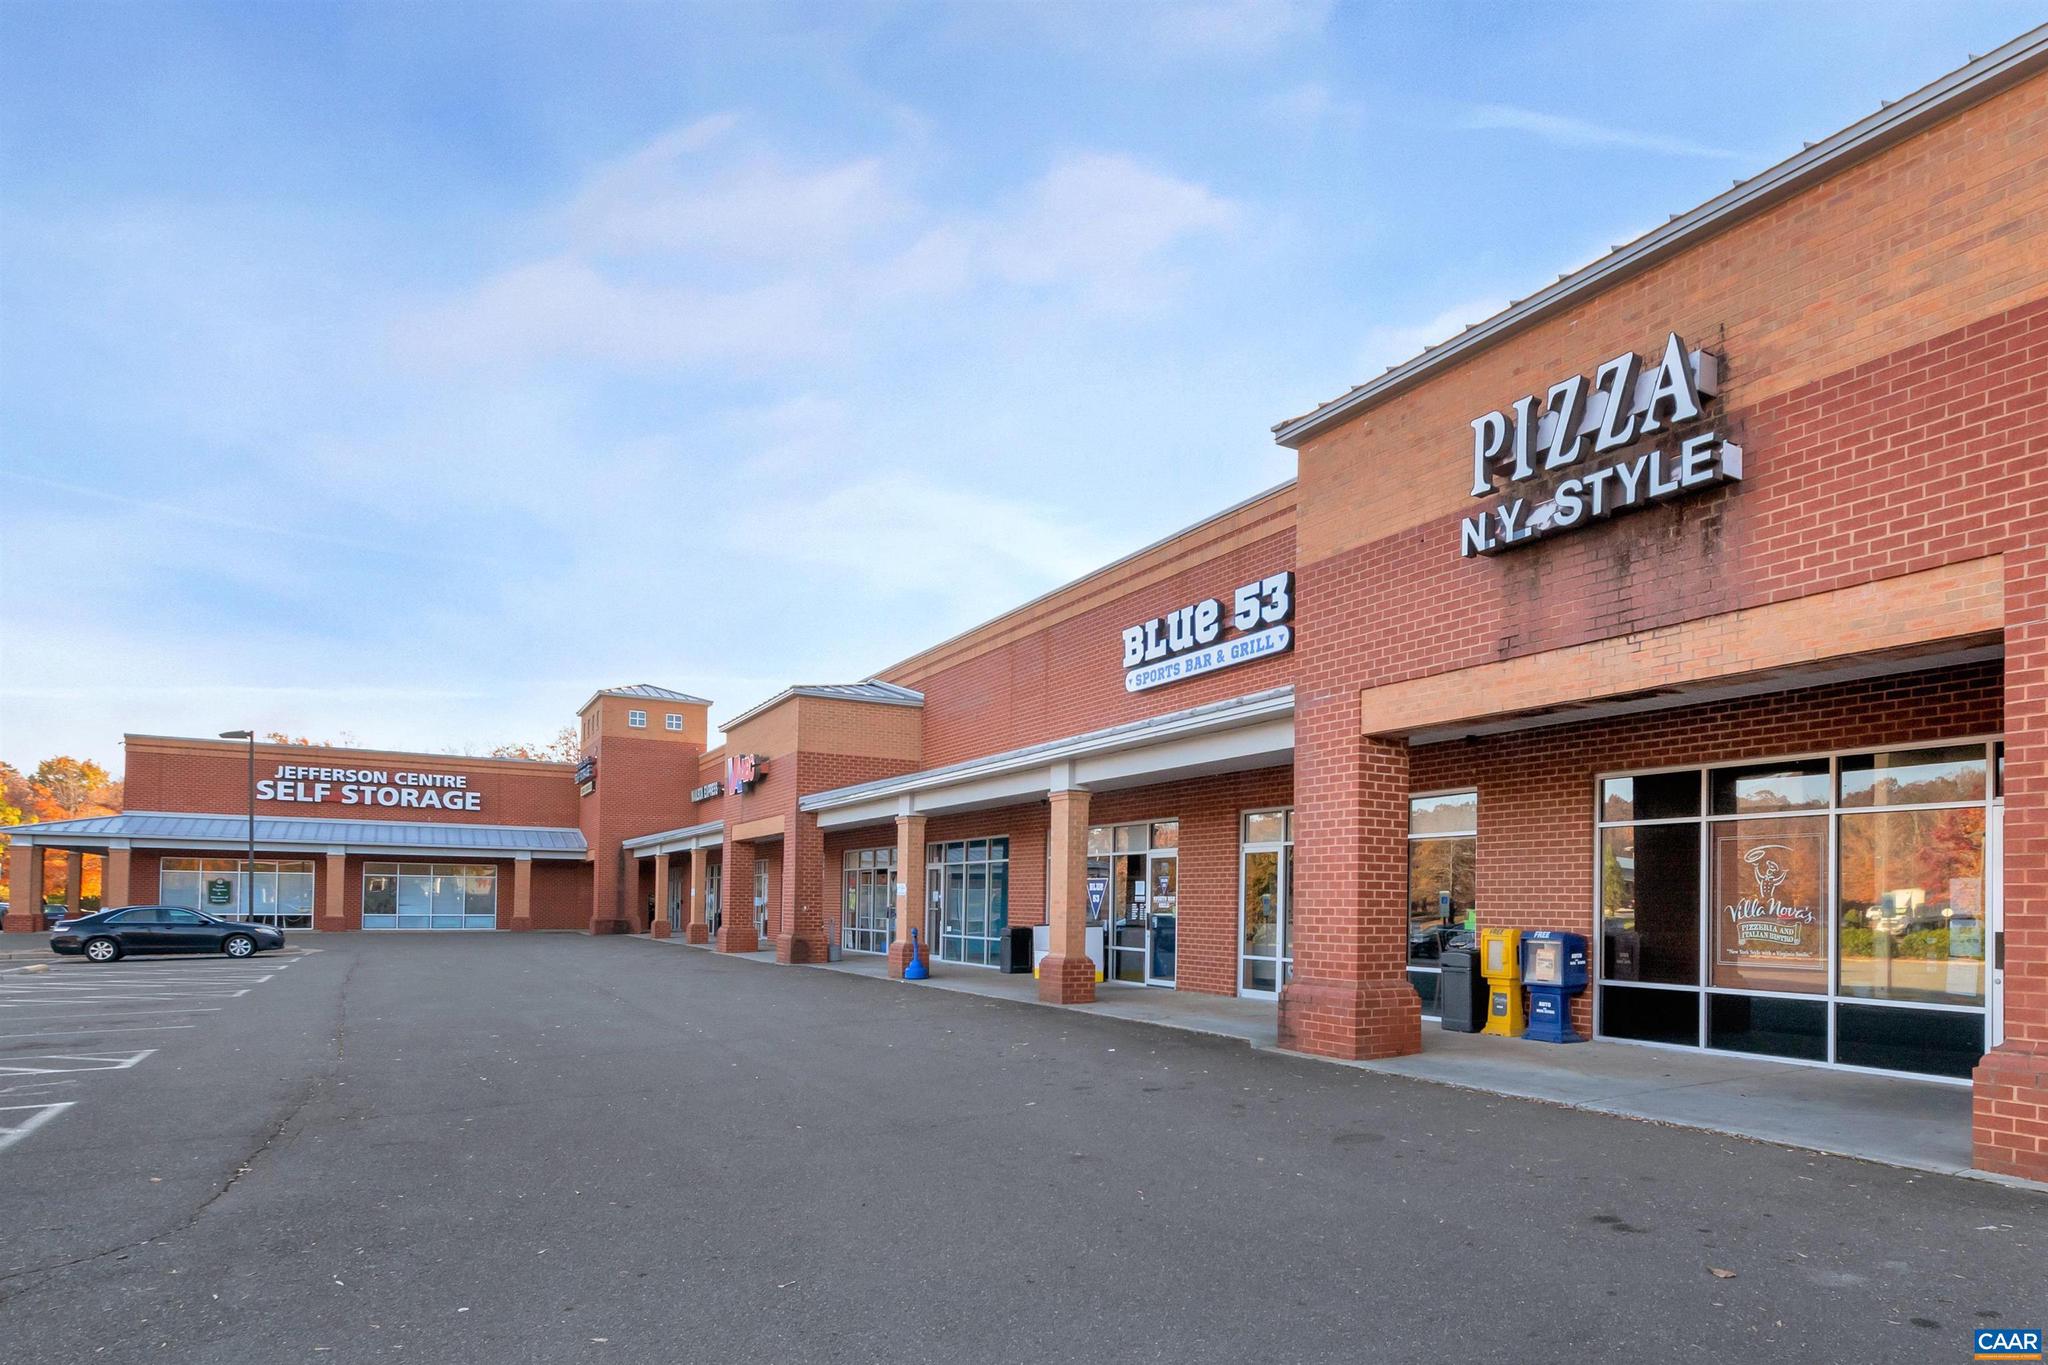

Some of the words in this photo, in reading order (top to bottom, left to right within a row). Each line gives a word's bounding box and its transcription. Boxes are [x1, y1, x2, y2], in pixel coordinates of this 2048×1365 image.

[1470, 331, 1699, 497] PIZZA
[1461, 498, 1532, 557] N.Y.
[1553, 432, 1716, 526] STYLE
[1234, 571, 1290, 631] 53
[1135, 662, 1181, 687] SPORTS
[1185, 652, 1212, 673] BAR
[1216, 649, 1225, 663] &
[1230, 634, 1275, 660] GRILL
[274, 765, 388, 784] JEFFERSON
[394, 772, 467, 788] CENTRE
[256, 780, 331, 803] SELF
[341, 784, 481, 811] STORAGE
[1089, 882, 1104, 891] BLUE
[1723, 898, 1766, 922] Villa
[1767, 898, 1817, 924] Nova's
[1533, 931, 1551, 939] FREE
[1741, 924, 1777, 933] PIZZERIA
[1780, 927, 1794, 935] AND
[1741, 930, 1768, 939] ITALIAN
[1769, 933, 1794, 943] BISTRO
